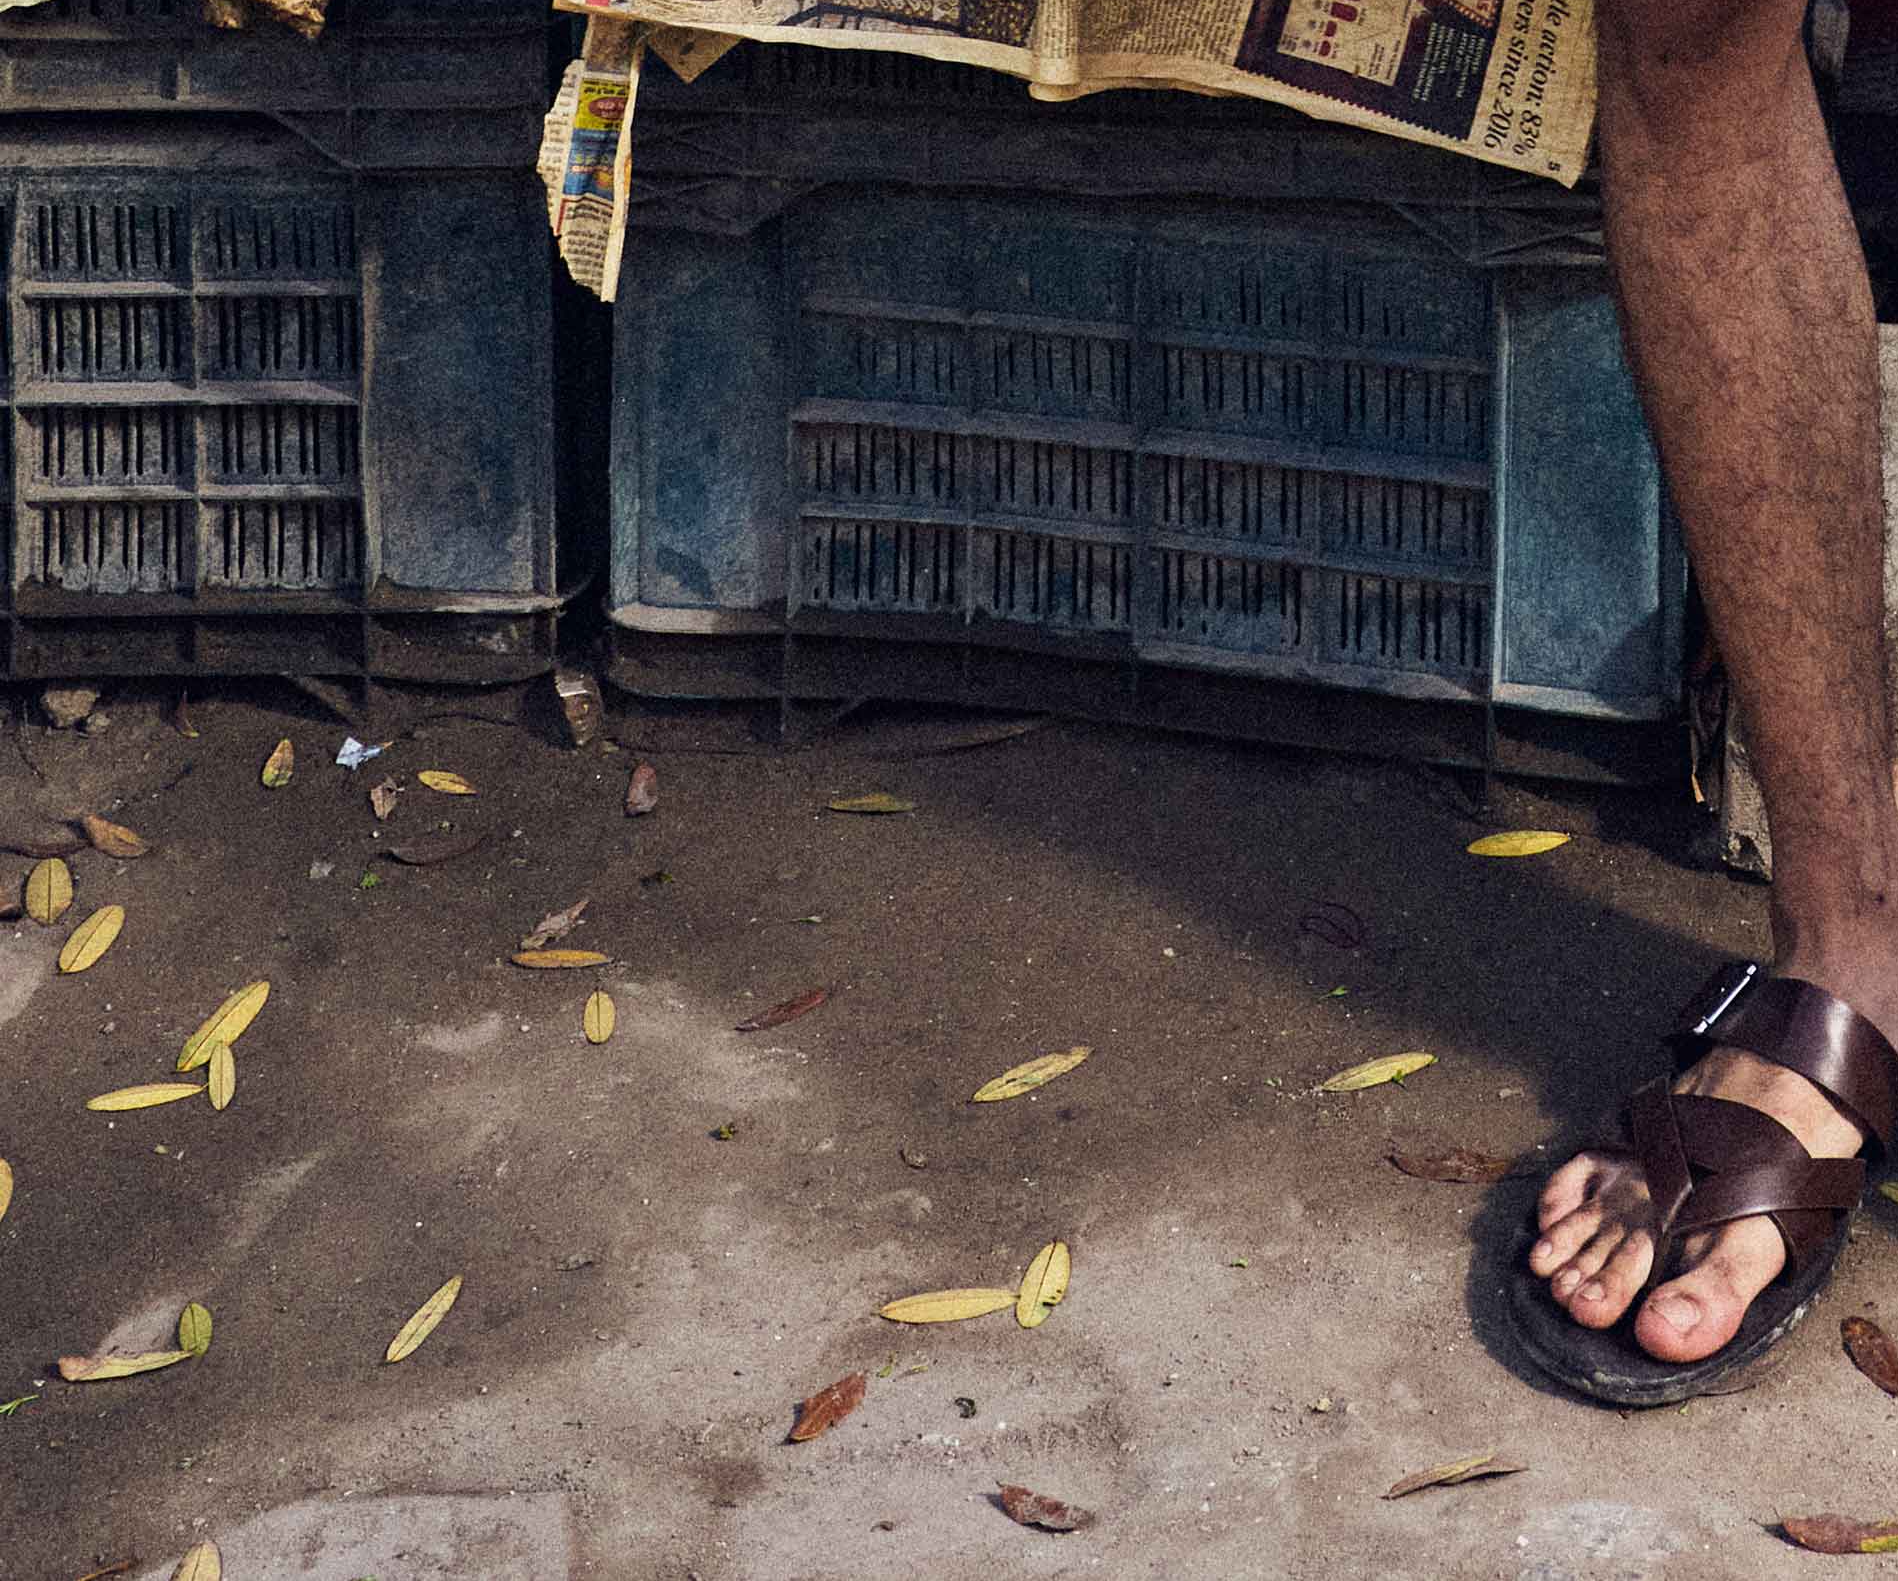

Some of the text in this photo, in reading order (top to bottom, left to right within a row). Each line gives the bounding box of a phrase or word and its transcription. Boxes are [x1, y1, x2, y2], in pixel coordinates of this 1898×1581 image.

[1484, 36, 1529, 149] since 2016
[1525, 29, 1561, 107] action:
[1512, 109, 1544, 155] 83%
